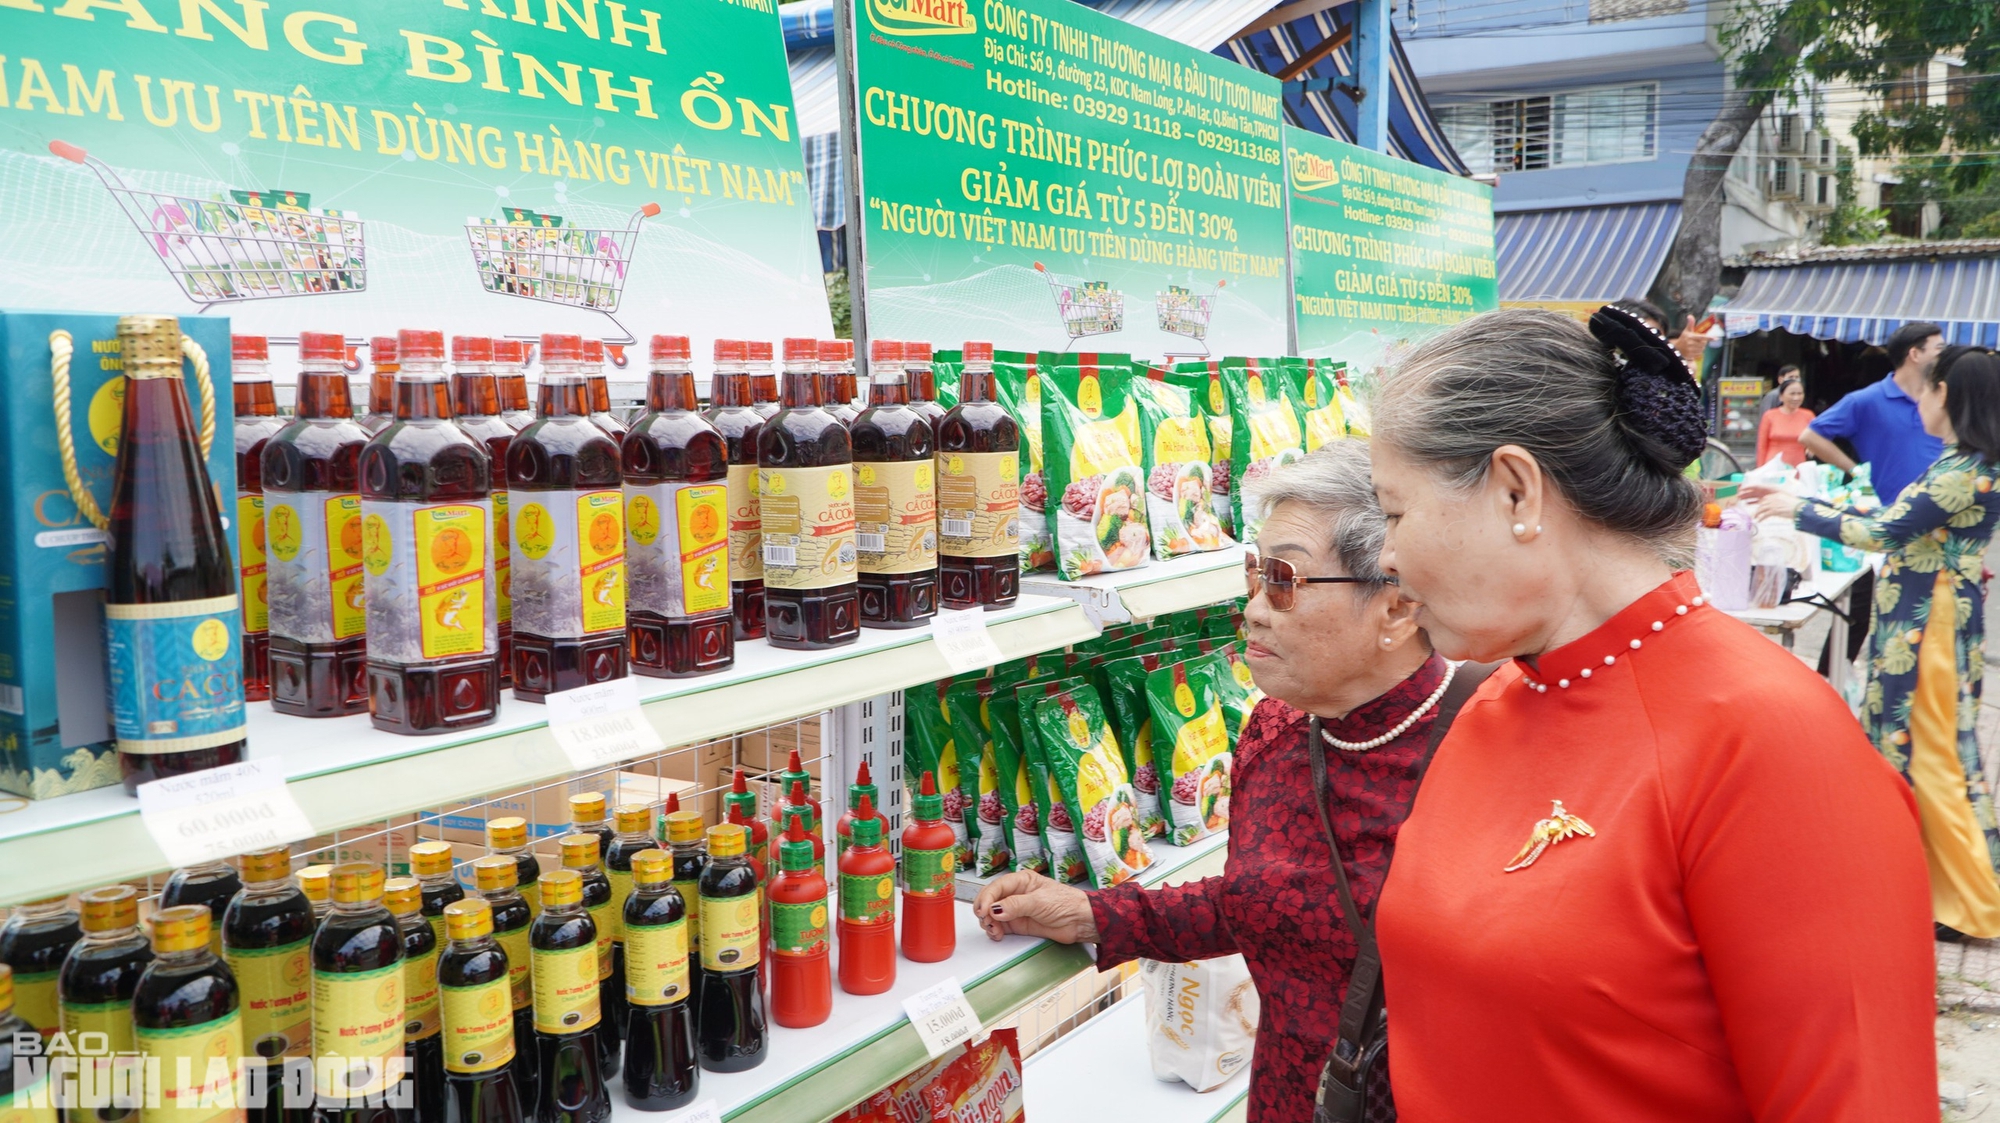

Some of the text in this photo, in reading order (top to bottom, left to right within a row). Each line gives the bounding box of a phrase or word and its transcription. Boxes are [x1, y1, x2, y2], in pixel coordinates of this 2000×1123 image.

[0, 0, 790, 142] NG BÌNH ỔN
[984, 37, 1004, 65] Địa
[1006, 43, 1028, 69] Chỉ:
[1030, 50, 1044, 73] Số
[1045, 56, 1056, 81] 9,
[1057, 59, 1092, 92] đường
[1093, 71, 1108, 96] 23,
[1110, 75, 1130, 99] KDC
[1131, 82, 1152, 105] Nam
[1153, 89, 1175, 116] Long,
[1031, 13, 1048, 46] TY
[1050, 20, 1088, 60] TNHH
[1091, 34, 1146, 78] THƯƠNG
[1148, 54, 1171, 91] MẠI
[1173, 62, 1183, 90] &
[1184, 58, 1207, 98] ĐẦU
[1208, 75, 1224, 103] TƯ
[1225, 80, 1250, 112] TƯƠI
[1251, 91, 1279, 121] MART
[134, 74, 222, 133] ƯU
[233, 84, 362, 151] TIÊN
[371, 102, 507, 169] DÙNG
[514, 124, 631, 187] HÀNG
[635, 143, 712, 205] VIỆT
[986, 69, 1068, 110] Hotline:
[1073, 94, 1128, 125] 03929
[1132, 110, 1182, 139] 11118
[1197, 129, 1281, 165] 0929113168
[865, 86, 1282, 209] CHƯƠNG TRÌNH PHÚC LỢI ĐOÀN VIÊN
[1341, 155, 1362, 184] CÔNG
[960, 161, 1238, 243] GIẢM GIÁ TỪ 5 ĐẾN 30%
[1343, 205, 1384, 226] Hotline:
[1385, 214, 1414, 231] 03929
[869, 196, 956, 239] “NGƯỜI
[959, 207, 1007, 252] VIỆT
[1010, 219, 1057, 251] NAM
[1059, 227, 1085, 256] ƯU
[1088, 227, 1127, 261] TIÊN
[1130, 232, 1173, 266] DÙNG
[1176, 239, 1217, 271] HÀNG
[1218, 245, 1248, 281] VIỆT
[1292, 224, 1496, 279] CHƯƠNG TRÌNH PHÚC LỢI ĐOÀN VIÊN
[1334, 263, 1473, 305] GIẢM GIÁ TỪ 5 ĐẾN 30%
[1335, 294, 1359, 323] VIỆT
[1359, 301, 1383, 320] NAM
[1397, 301, 1417, 323] TIÊN
[1418, 303, 1440, 324] DÙNG
[570, 716, 635, 743] 18.000đ
[177, 801, 276, 838] 60.000đ
[925, 1006, 966, 1034] 15.000đ
[1177, 976, 1201, 1036] Ngọc
[950, 1069, 1013, 1123] ji-ngon
